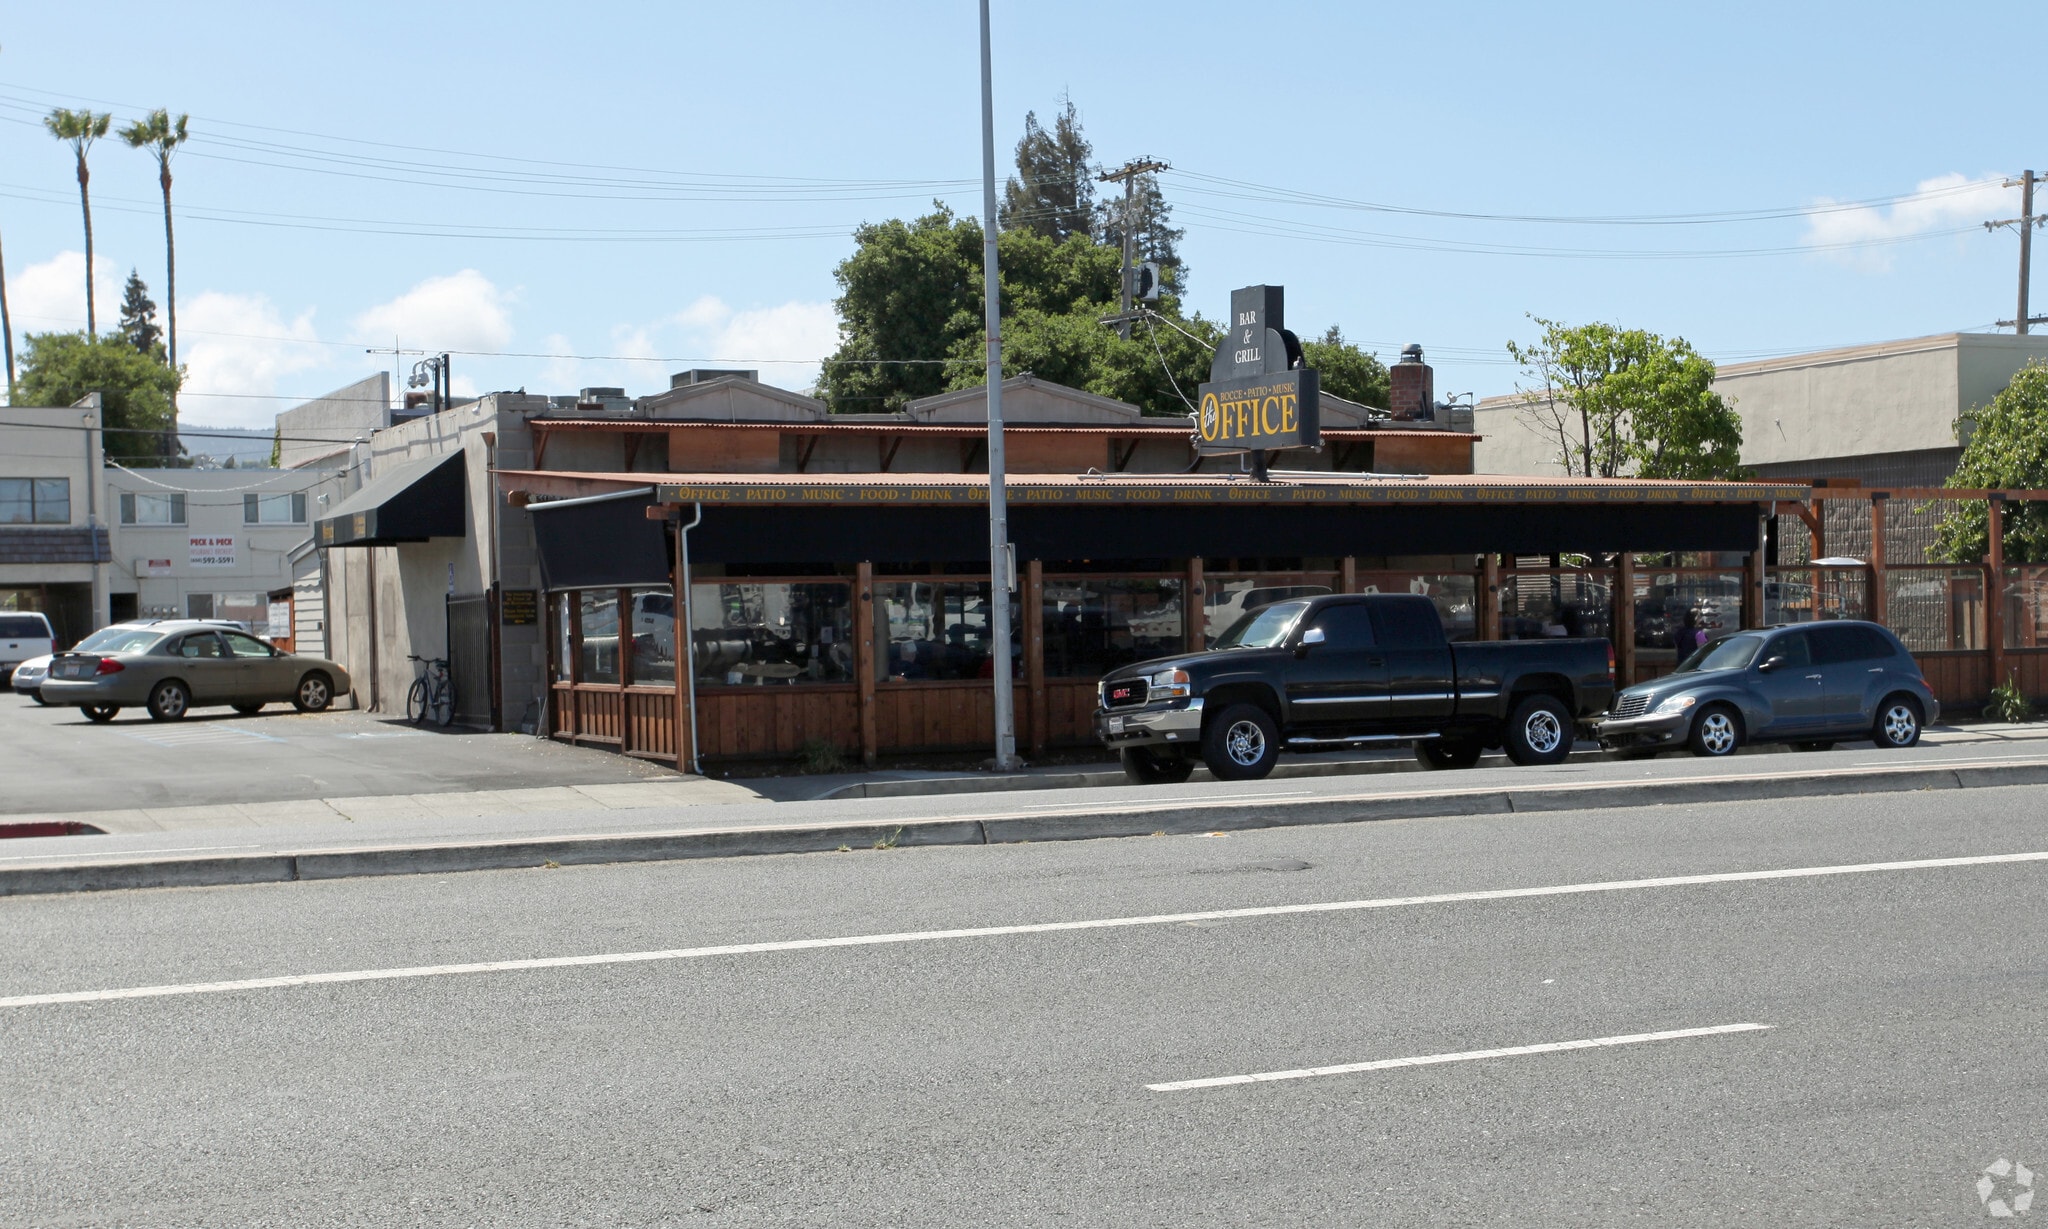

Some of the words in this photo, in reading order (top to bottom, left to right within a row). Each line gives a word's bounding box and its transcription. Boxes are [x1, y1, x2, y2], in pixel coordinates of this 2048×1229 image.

[1239, 310, 1256, 326] BAR
[1243, 329, 1253, 344] &
[1235, 348, 1260, 363] GRILL
[1220, 390, 1243, 401] BOCCE
[1247, 386, 1268, 398] PATIO
[1272, 382, 1295, 394] MUSIC
[1200, 393, 1297, 441] OFFICE
[1204, 401, 1217, 428] the
[679, 486, 730, 500] OFFICE
[746, 489, 786, 500] PATIO
[802, 489, 845, 500] MUSIC
[860, 489, 899, 500] FOOD
[911, 489, 952, 500] DRINK
[1026, 489, 1063, 500] PATIO
[1075, 489, 1114, 500] MUSIC
[1125, 489, 1161, 500] FOOD
[1174, 489, 1213, 500] DRINK
[1228, 487, 1271, 500] OFFICE
[1292, 489, 1326, 500] PATIO
[1338, 489, 1374, 500] MUSIC
[1386, 489, 1419, 500] FOOD
[1429, 489, 1464, 500] DRINK
[1476, 488, 1515, 500] OFFICE
[1525, 489, 1557, 500] PATIO
[1566, 489, 1599, 499] MUSIC
[1608, 489, 1638, 499] FOOD
[1647, 489, 1680, 499] DRINK
[1691, 487, 1728, 499] OFFICE
[1736, 488, 1766, 498] PATIO
[1773, 488, 1806, 498] MUSIC
[190, 538, 207, 546] PECK
[209, 538, 214, 546] &
[215, 538, 232, 546] PECK
[1113, 688, 1130, 698] GMC
